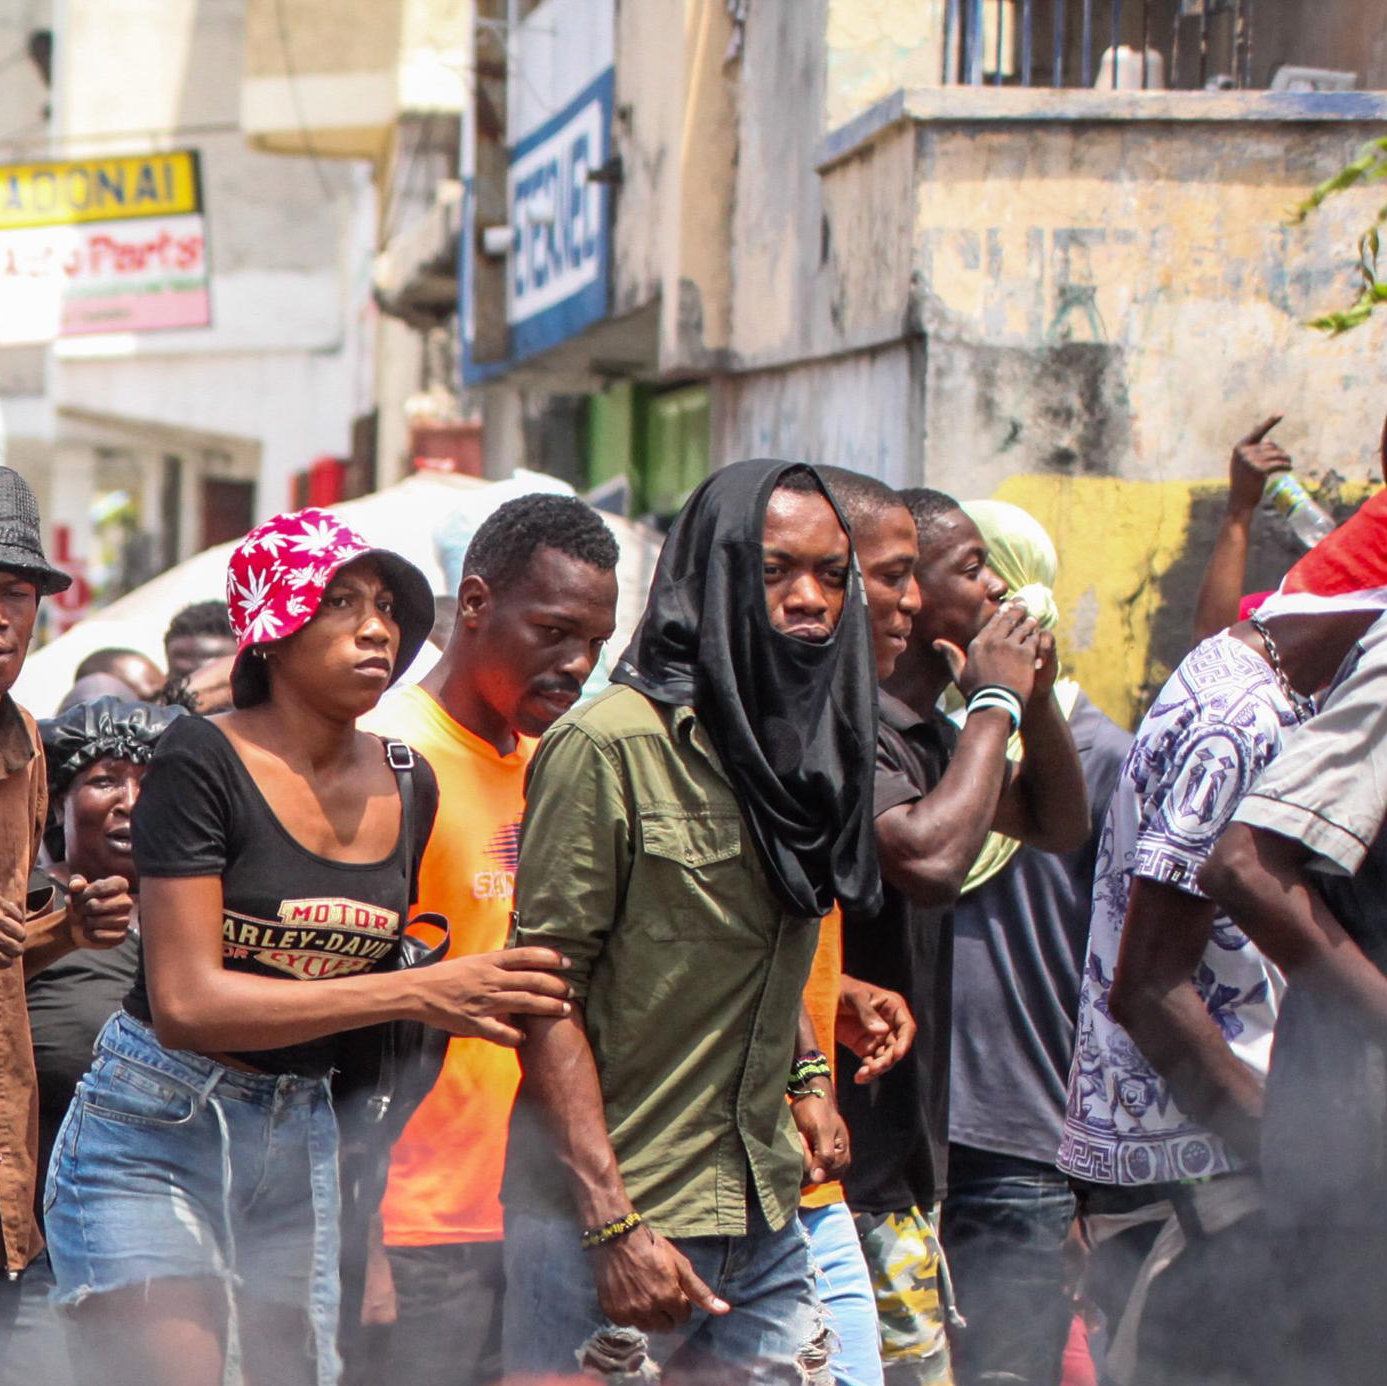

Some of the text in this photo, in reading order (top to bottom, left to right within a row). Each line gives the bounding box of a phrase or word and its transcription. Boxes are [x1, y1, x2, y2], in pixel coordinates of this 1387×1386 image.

[5, 160, 176, 212] ADONAI
[88, 228, 204, 274] Parts
[291, 903, 391, 930] MOTOR
